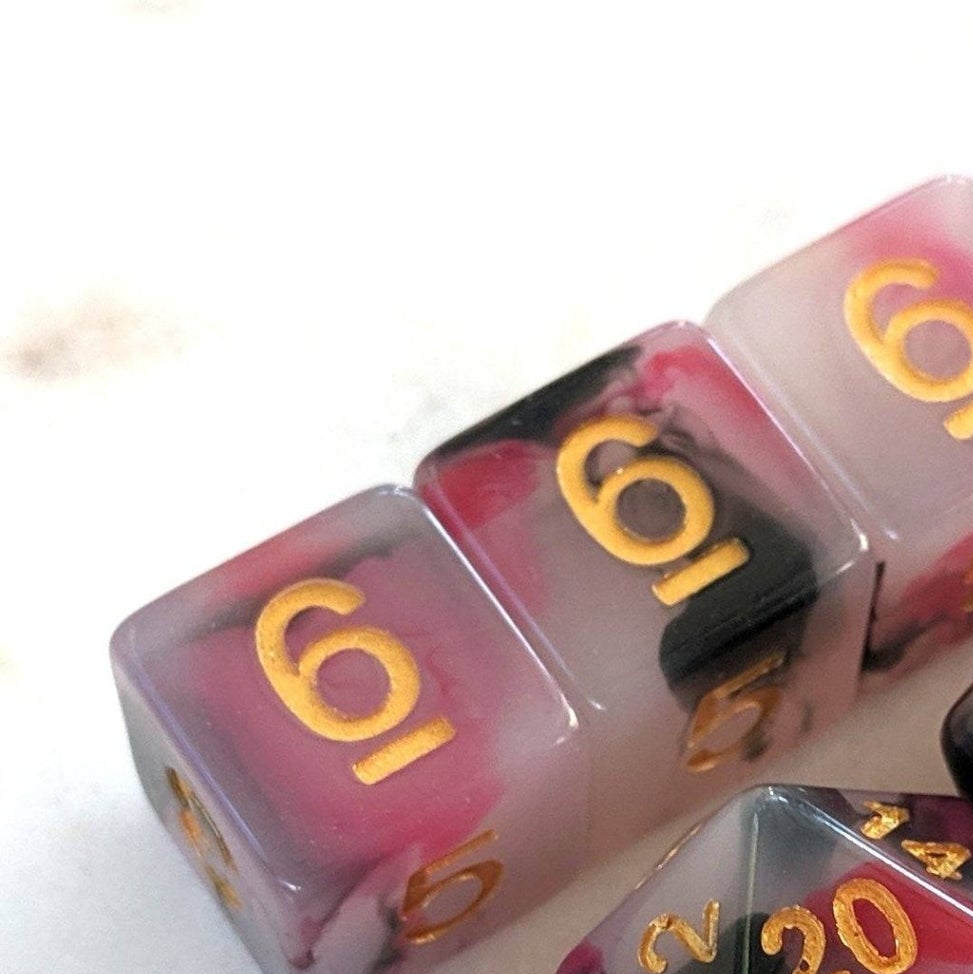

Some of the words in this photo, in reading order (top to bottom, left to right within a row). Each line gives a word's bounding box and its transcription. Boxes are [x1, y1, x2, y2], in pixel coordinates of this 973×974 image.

[687, 652, 784, 772] 5
[402, 828, 504, 945] 5
[860, 800, 971, 880] 14
[638, 899, 720, 974] 2
